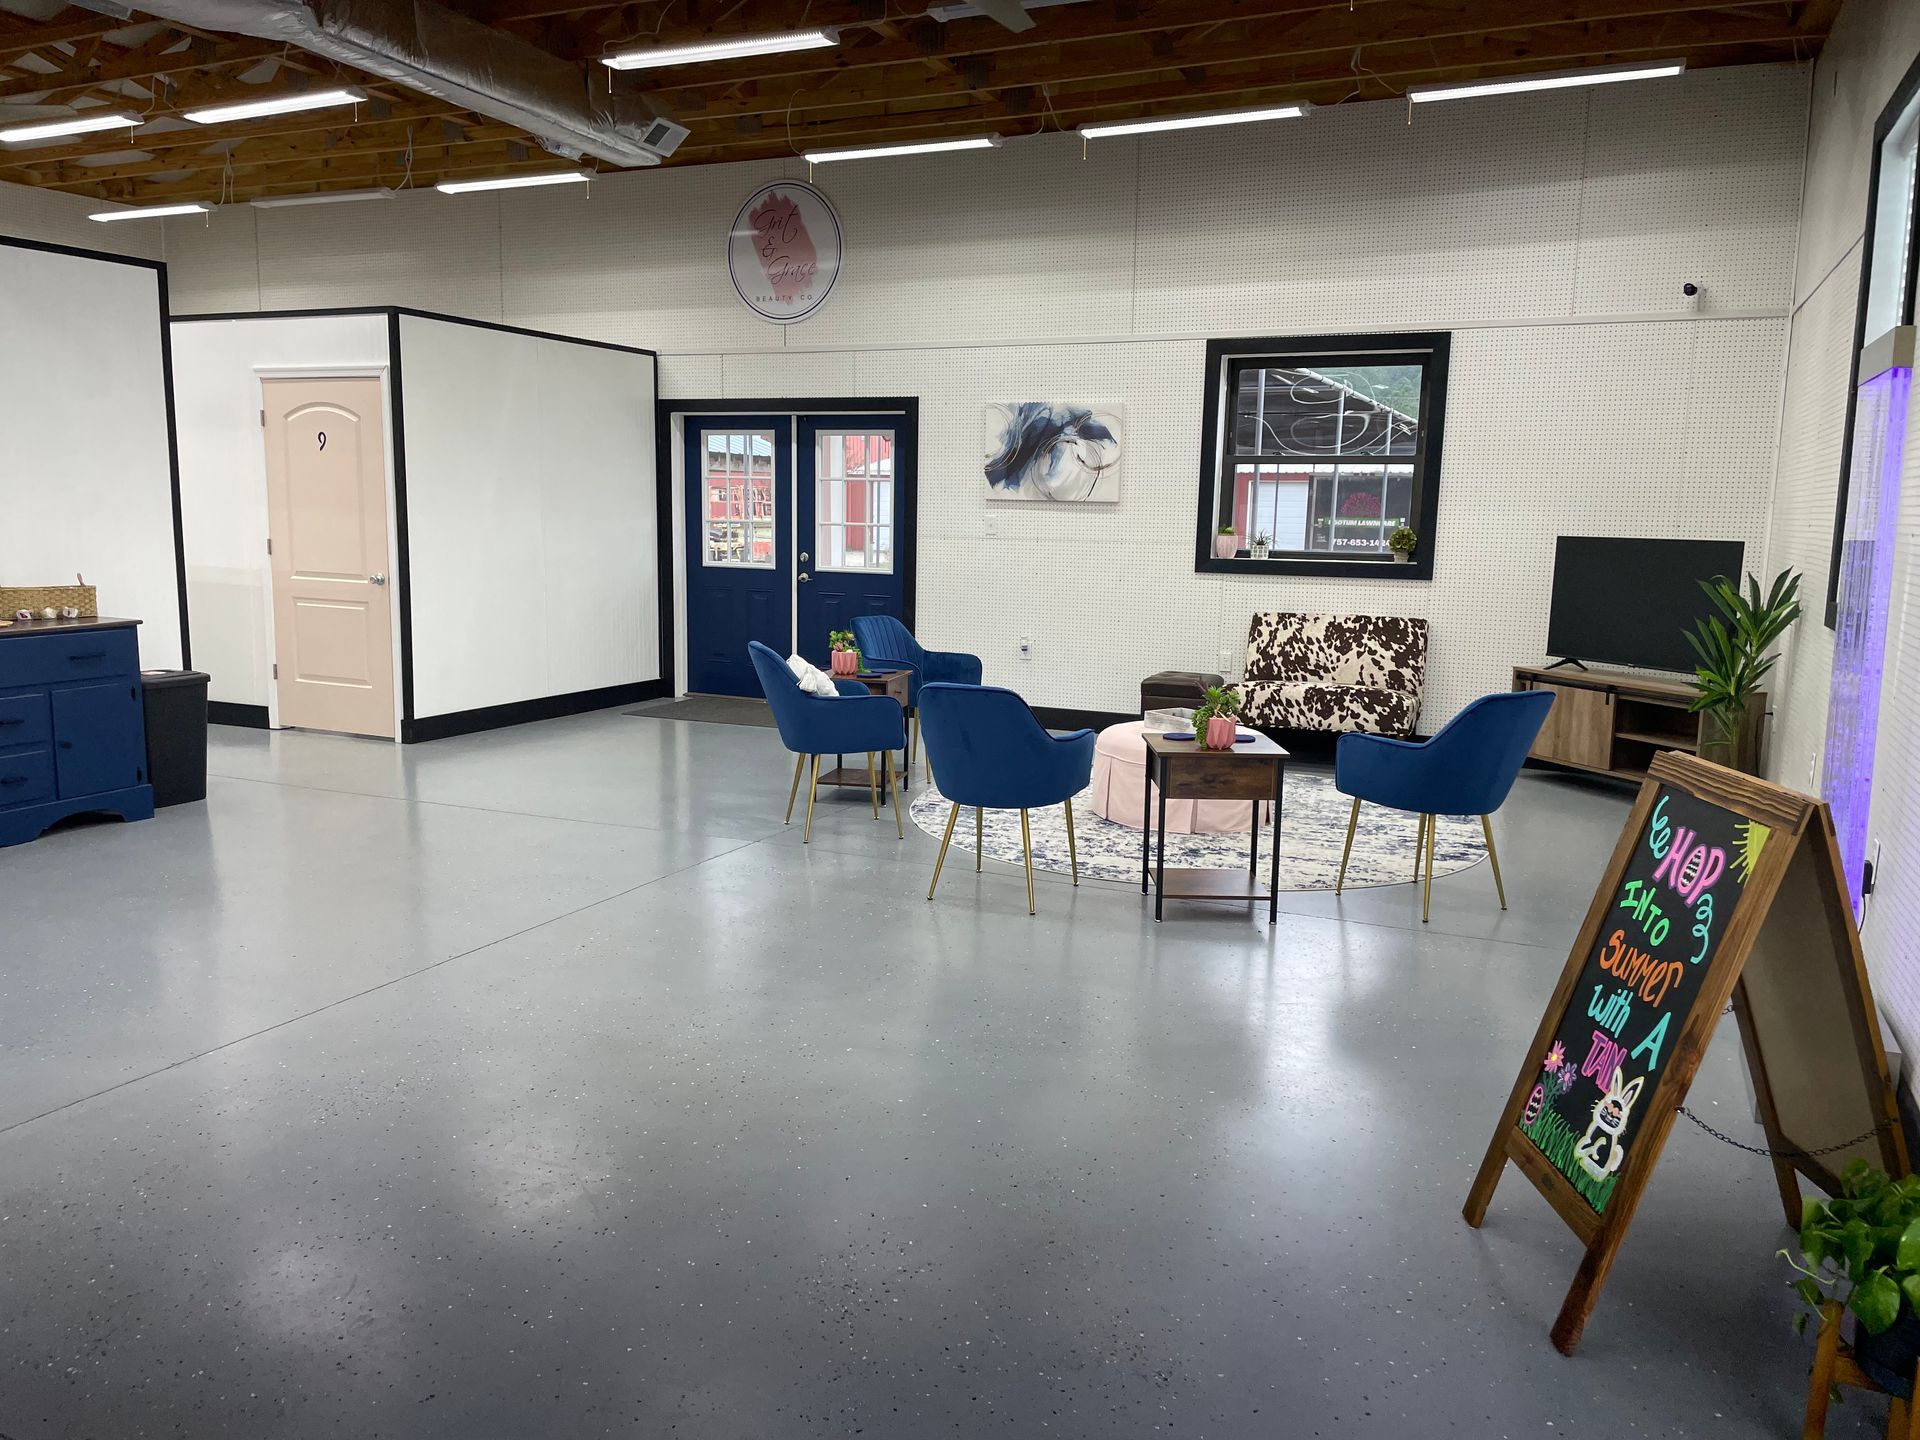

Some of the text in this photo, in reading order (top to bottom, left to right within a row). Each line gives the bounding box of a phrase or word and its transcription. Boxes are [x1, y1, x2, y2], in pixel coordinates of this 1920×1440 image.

[754, 205, 798, 243] Grit
[762, 236, 776, 259] &
[767, 255, 817, 284] Grace
[317, 431, 327, 452] 9
[1652, 826, 1726, 908] HOP
[1620, 880, 1670, 946] INTO
[1580, 1029, 1628, 1095] TAN
[1630, 1011, 1672, 1072] A
